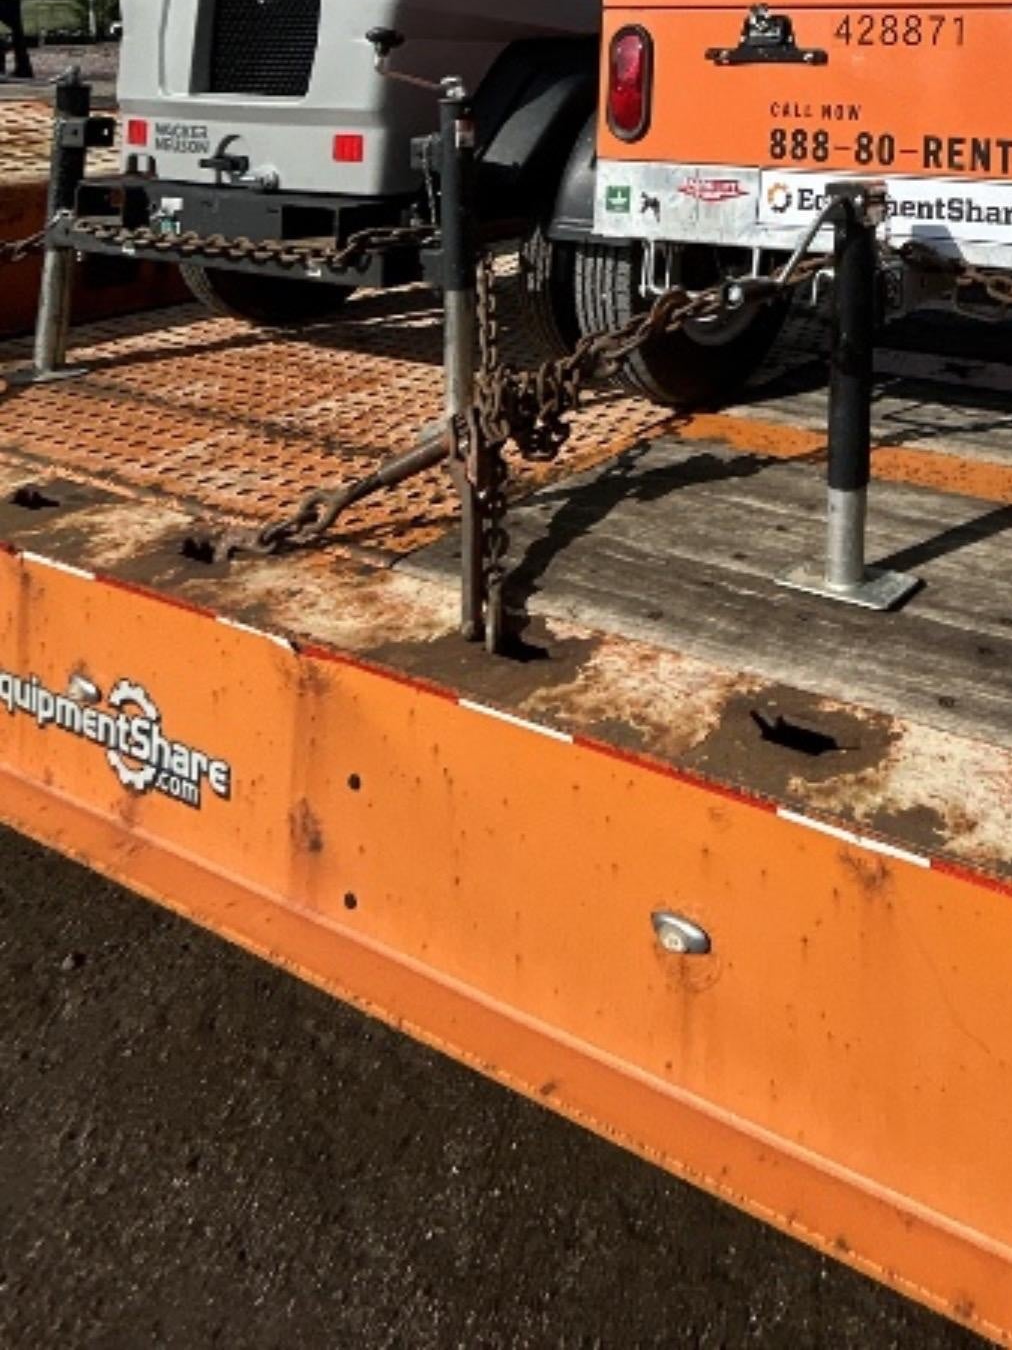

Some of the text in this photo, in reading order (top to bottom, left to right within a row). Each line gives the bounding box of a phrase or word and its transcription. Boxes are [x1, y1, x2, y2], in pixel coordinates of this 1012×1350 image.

[833, 13, 964, 47] 428871
[769, 100, 861, 121] CALL NOW
